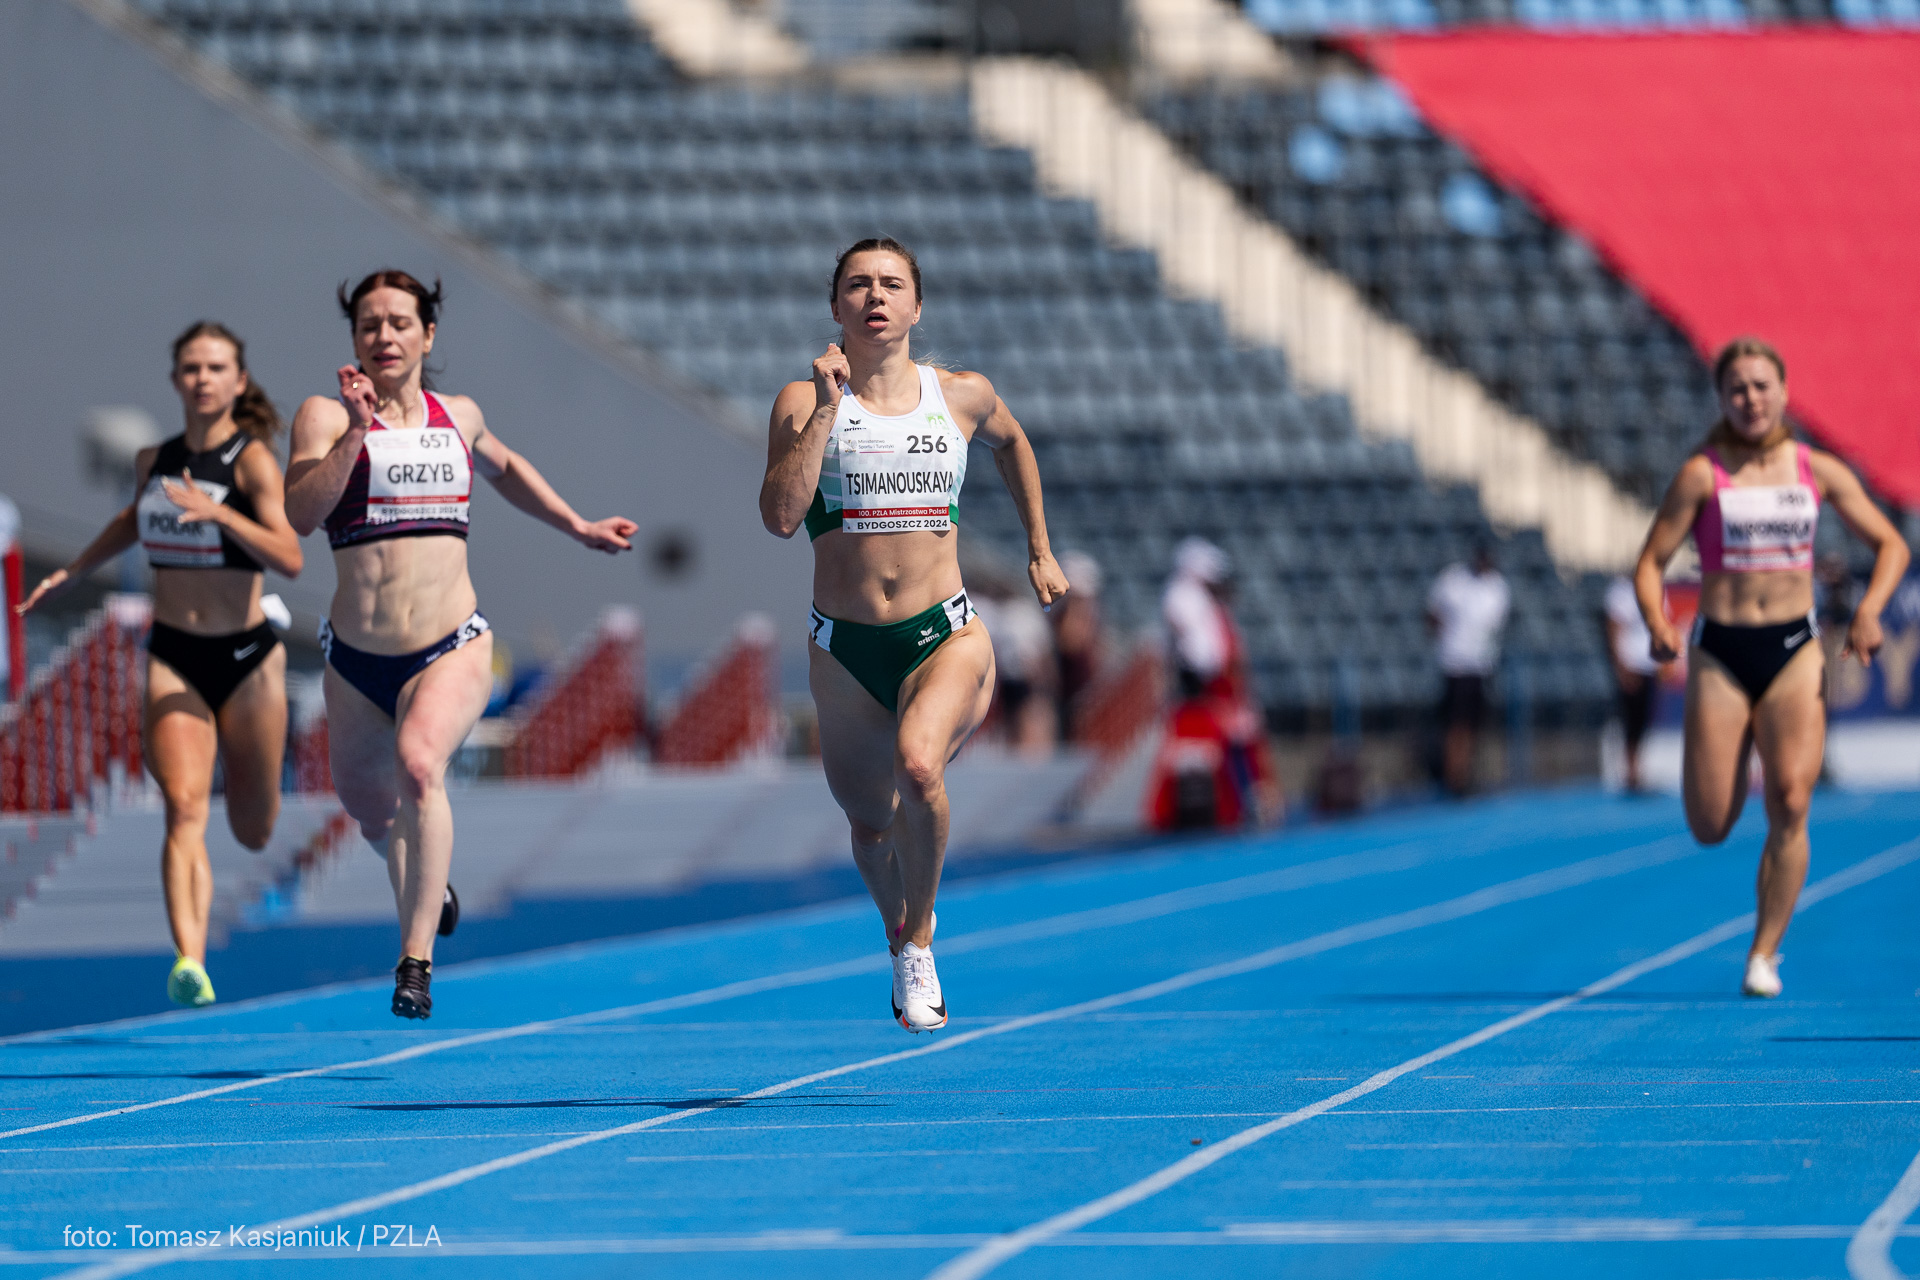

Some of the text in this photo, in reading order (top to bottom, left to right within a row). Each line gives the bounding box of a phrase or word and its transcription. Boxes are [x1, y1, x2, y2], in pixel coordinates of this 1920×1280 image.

[420, 433, 450, 449] 657
[906, 435, 948, 454] 256
[387, 463, 454, 484] GRZYB
[845, 471, 953, 496] TSIMANOUSKAYA
[889, 508, 928, 516] Mistrzostwa
[928, 507, 948, 515] Polski
[857, 519, 948, 530] BYDGOSZCZ 2024
[952, 594, 968, 627] 7
